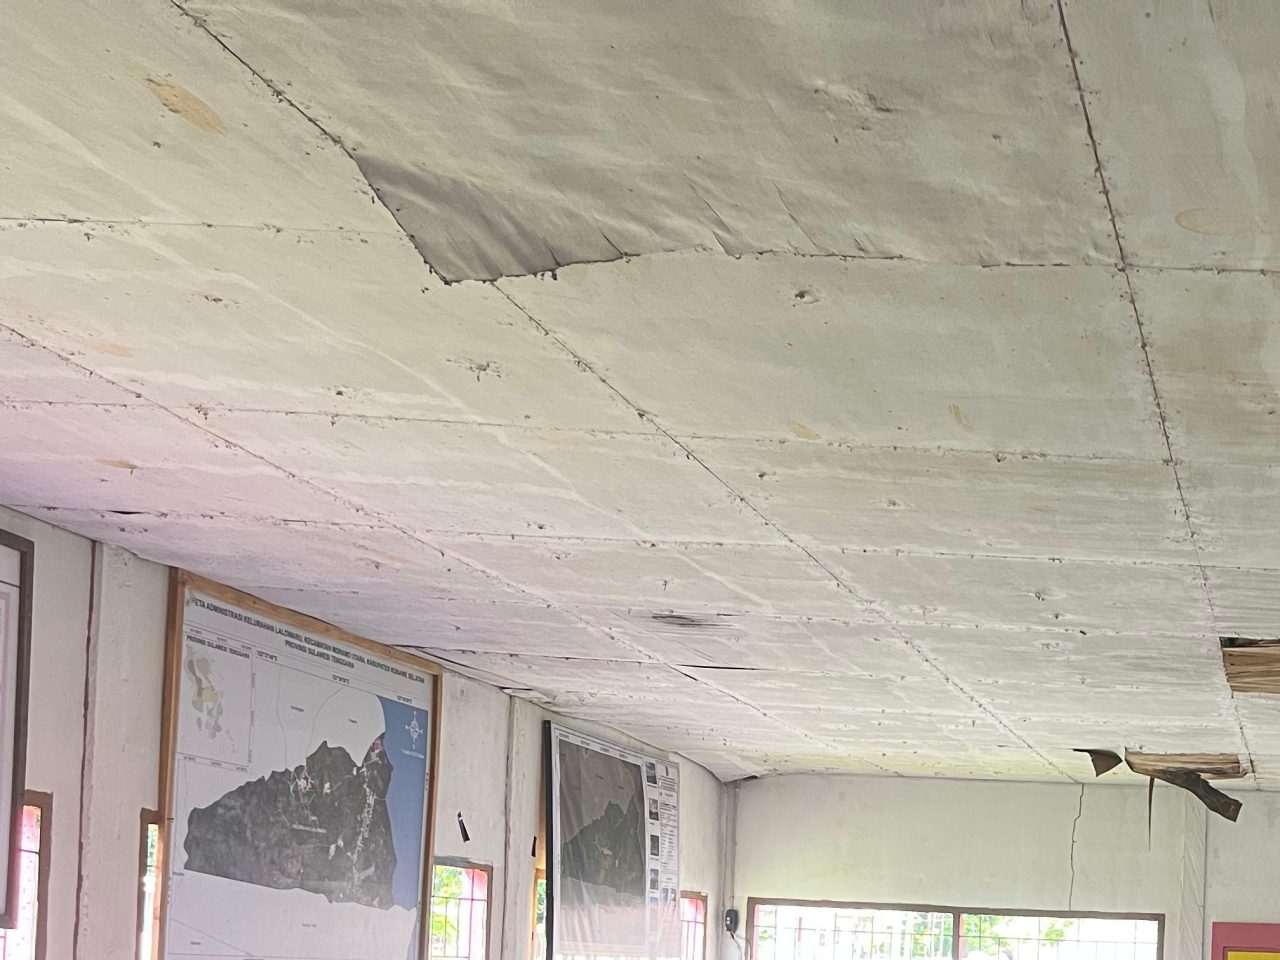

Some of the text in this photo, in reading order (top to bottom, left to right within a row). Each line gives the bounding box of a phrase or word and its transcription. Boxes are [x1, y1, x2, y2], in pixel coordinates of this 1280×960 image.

[285, 640, 355, 669] PROVINSI SULAWESI TENGGARA
